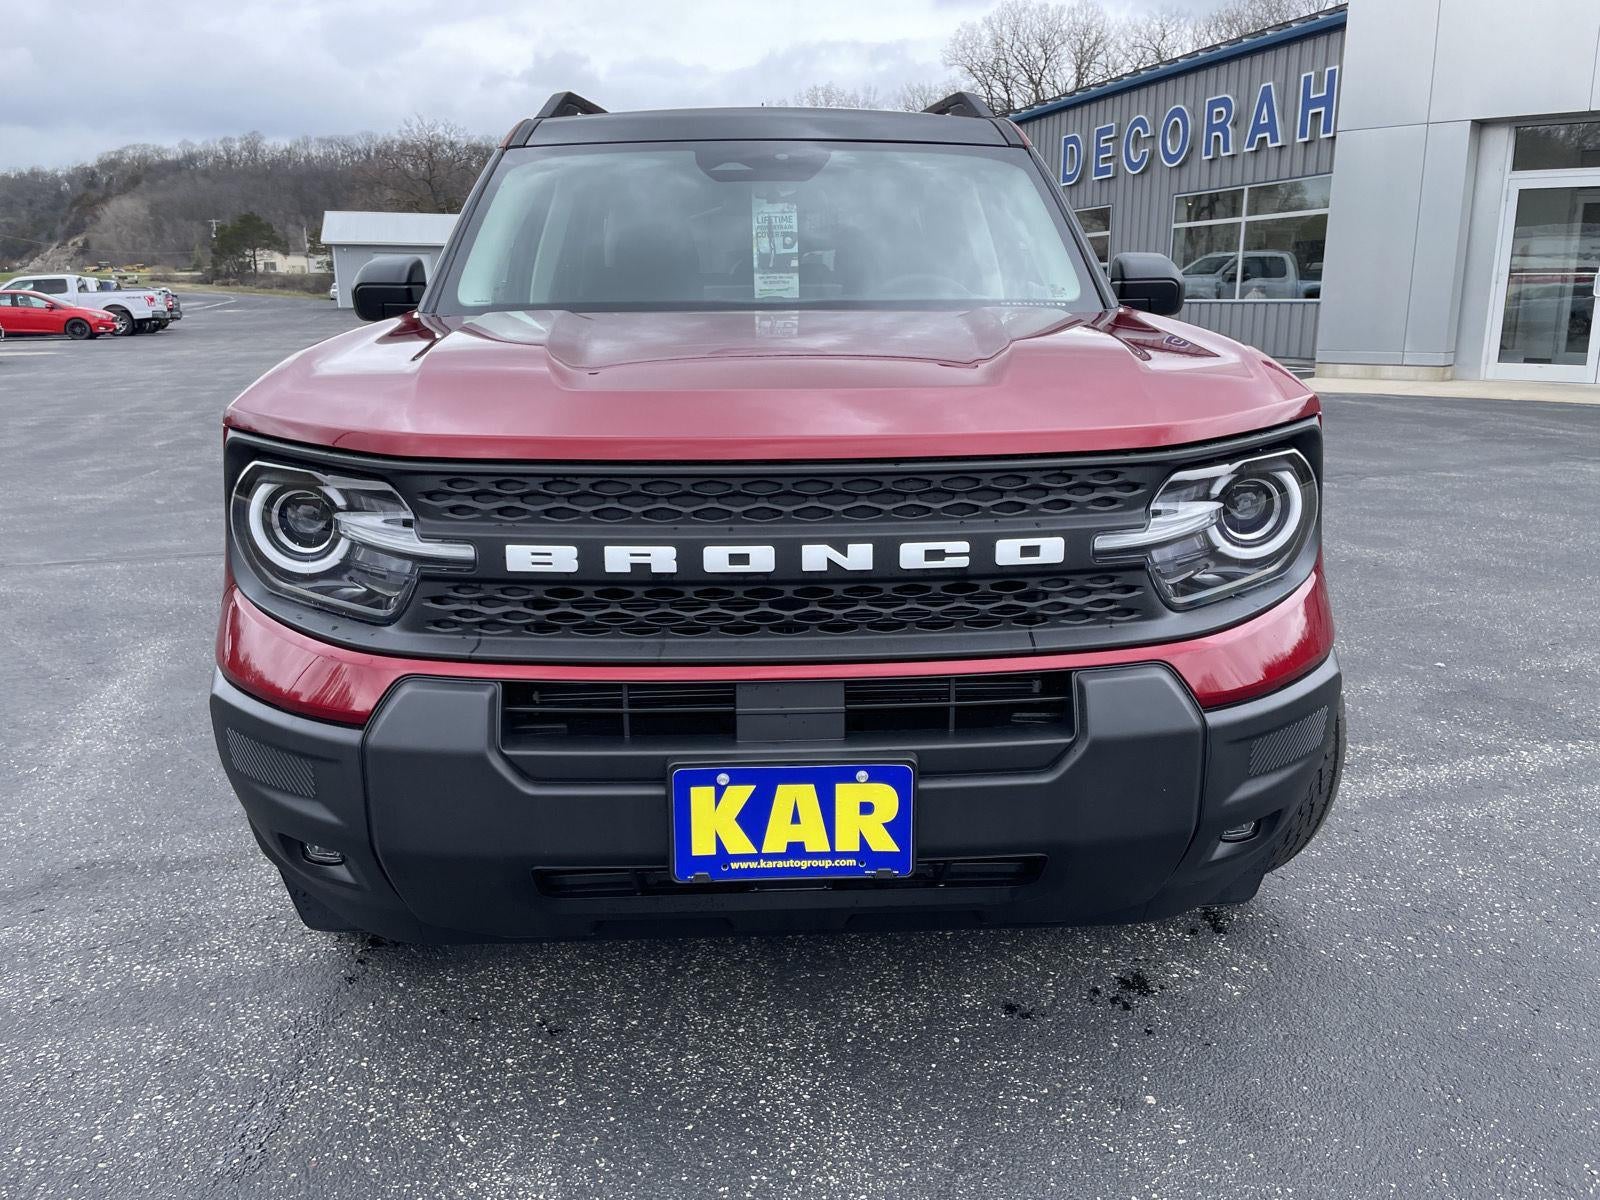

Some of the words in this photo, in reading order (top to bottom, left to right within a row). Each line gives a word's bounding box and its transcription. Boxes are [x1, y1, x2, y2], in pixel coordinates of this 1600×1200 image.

[1060, 65, 1339, 187] DECORAH
[505, 536, 1065, 573] BRONCO
[690, 783, 901, 856] KAR
[730, 857, 857, 871] www.karautogroup.com
